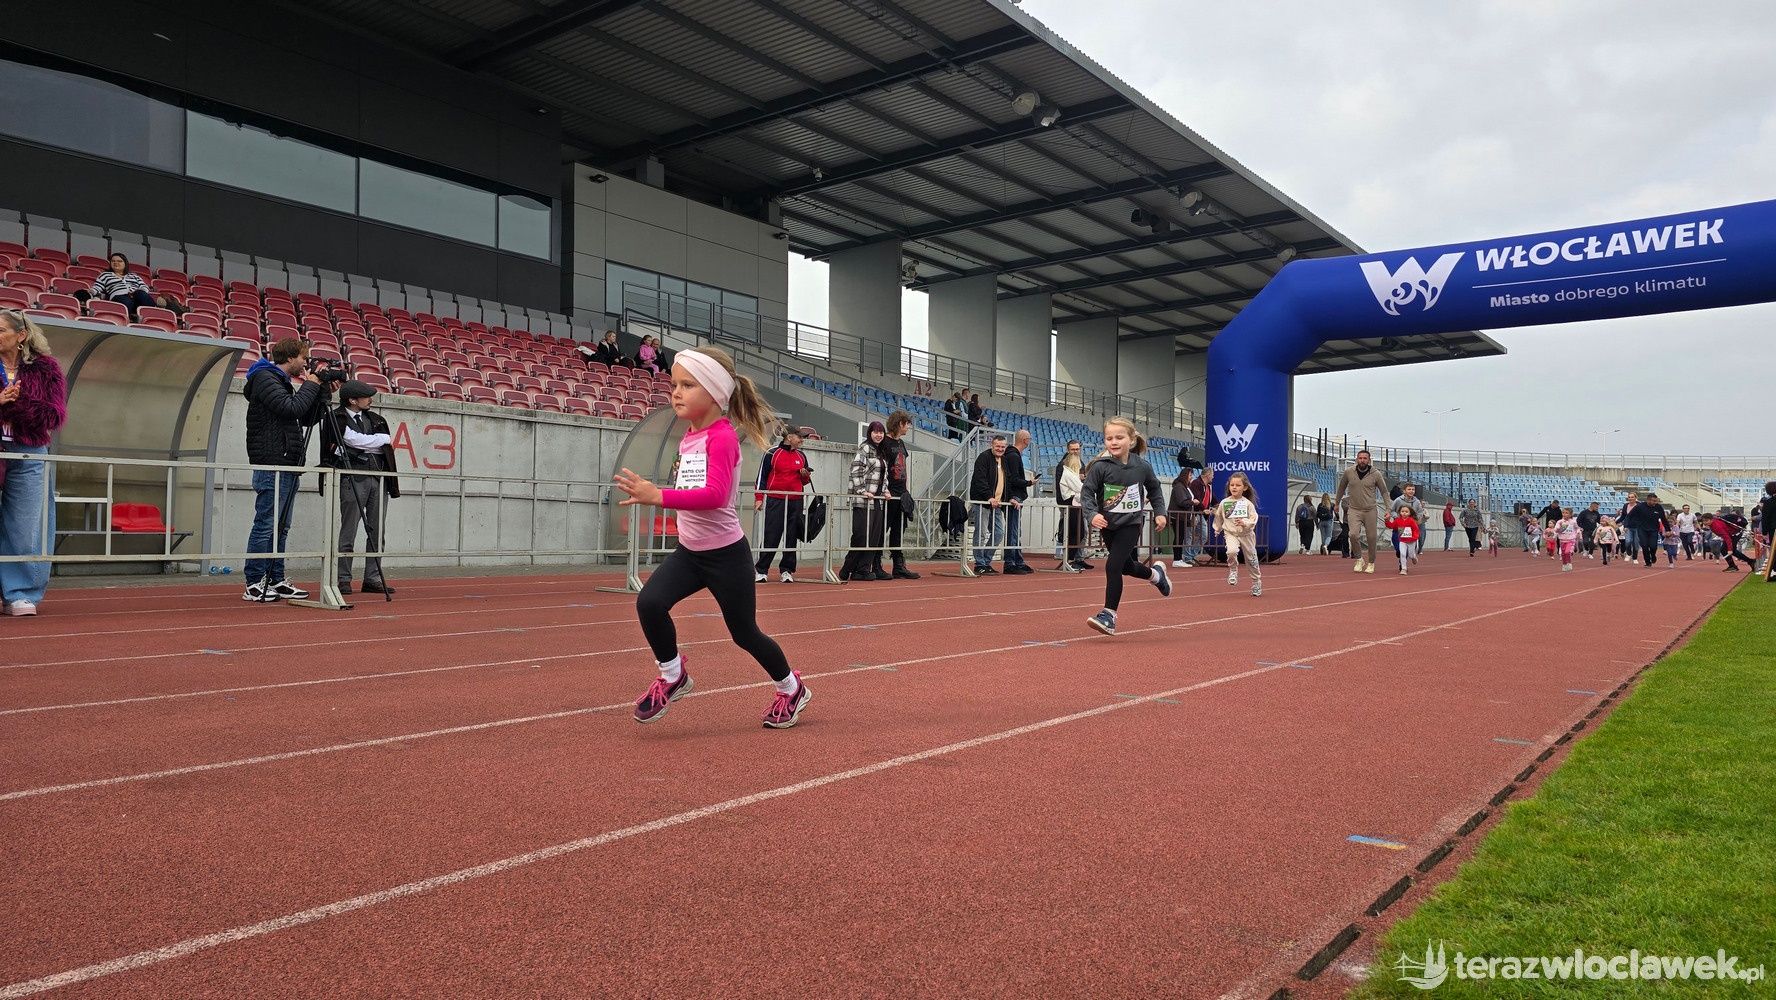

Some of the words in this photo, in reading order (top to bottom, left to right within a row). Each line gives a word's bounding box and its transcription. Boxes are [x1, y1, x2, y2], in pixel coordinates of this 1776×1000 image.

[1475, 218, 1724, 272] WŁOCŁAWEK
[1489, 292, 1550, 308] Miasto
[1554, 285, 1629, 302] dobrego
[1635, 275, 1707, 294] klimatu
[392, 421, 456, 470] A3
[1121, 500, 1139, 510] 169
